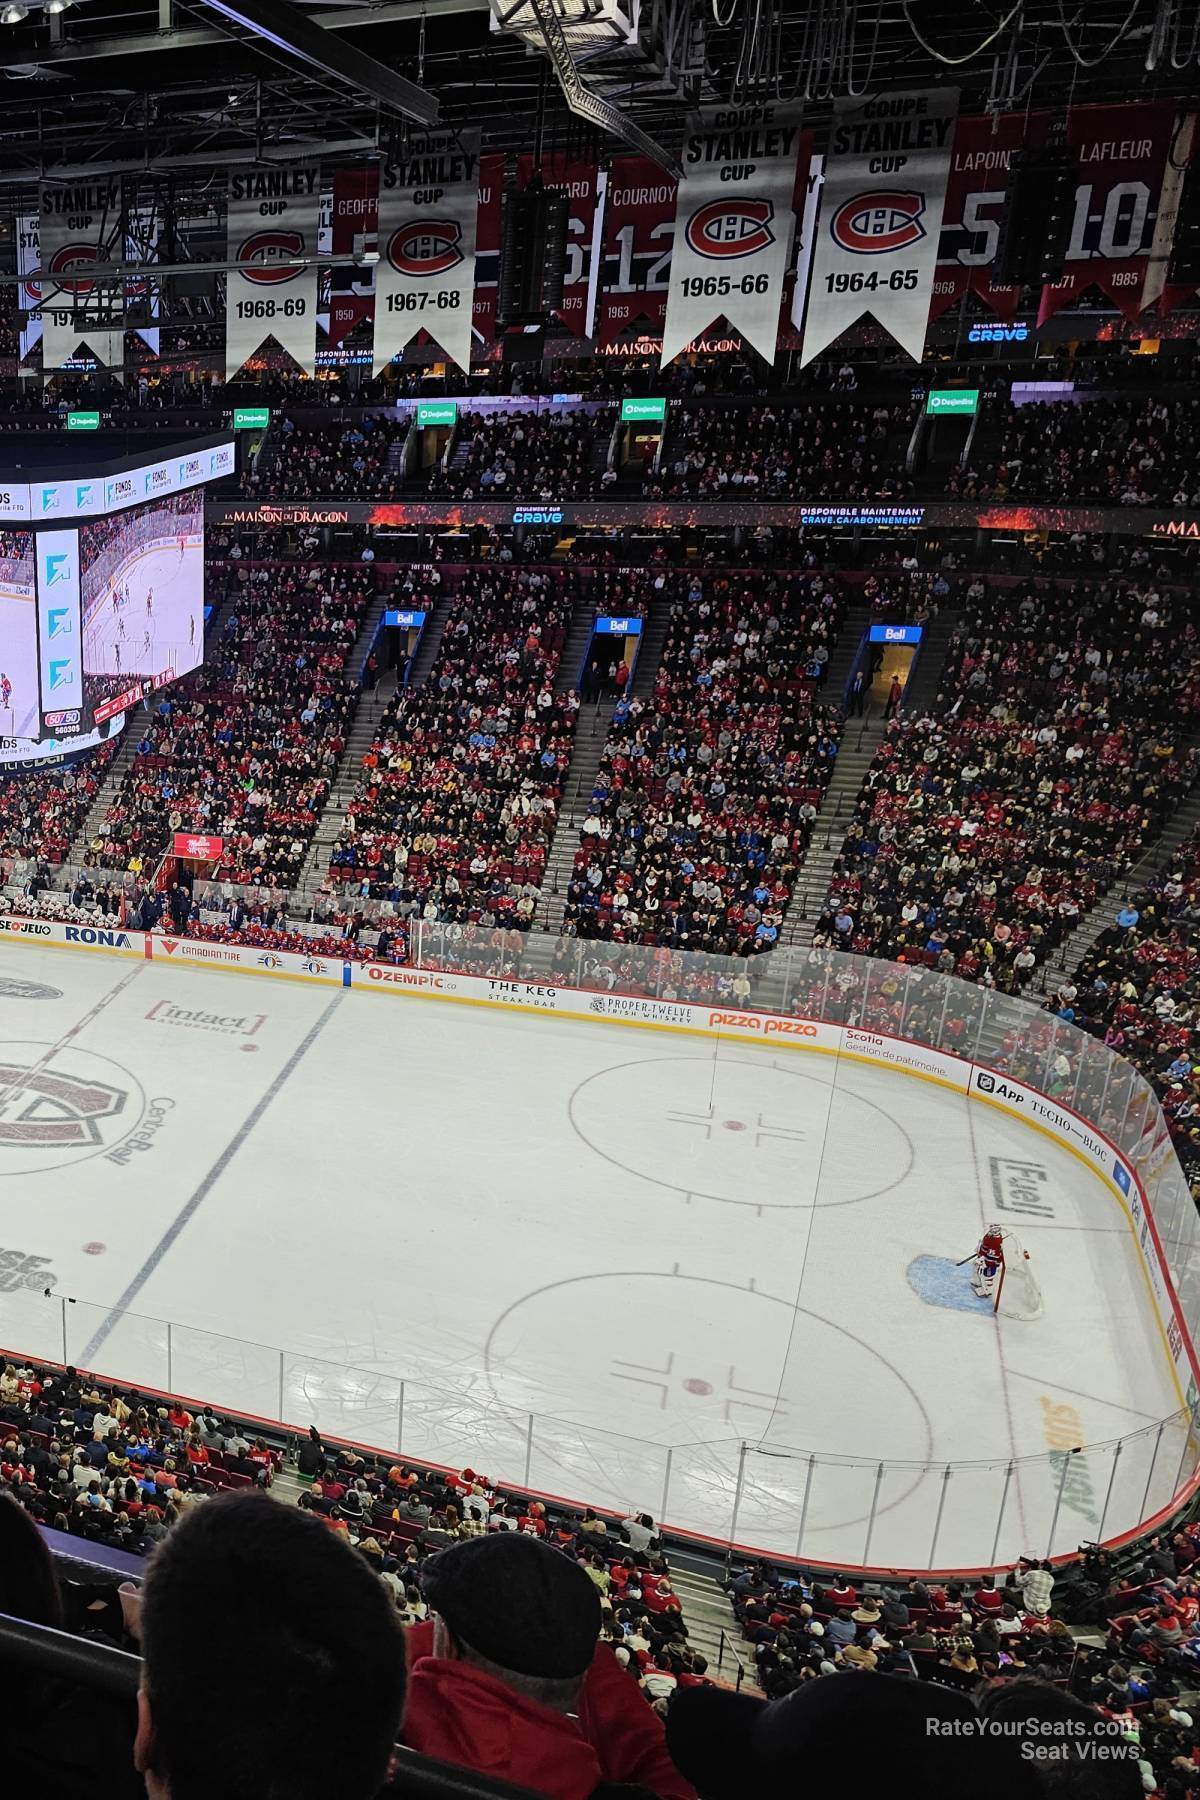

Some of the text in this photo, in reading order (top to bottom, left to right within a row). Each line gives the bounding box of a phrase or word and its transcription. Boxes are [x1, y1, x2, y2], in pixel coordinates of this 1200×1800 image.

[864, 96, 928, 116] COUPE
[715, 108, 775, 129] COUPE
[833, 119, 952, 154] STANLEY
[687, 127, 794, 164] STANLEY
[1080, 140, 1152, 163] LAFLEUR
[383, 154, 476, 187] STANLEY
[720, 165, 756, 181] CUP
[868, 156, 907, 174] CUP
[231, 168, 318, 199] STANLEY
[42, 184, 119, 214] STANLEY
[413, 189, 444, 205] CUP
[259, 201, 288, 217] CUP
[68, 216, 92, 231] CUP
[957, 190, 1006, 267] 5
[1065, 181, 1152, 261] 10
[681, 274, 769, 297] 1965-66
[825, 269, 919, 294] 1964-65
[1110, 272, 1139, 288] 1985
[236, 298, 306, 319] 1968-69
[386, 289, 461, 312] 1967-68
[563, 297, 583, 310] 1975
[335, 308, 355, 321] 1950
[608, 305, 630, 319] 1963
[683, 339, 742, 355] RAGON
[942, 397, 974, 408] Desjardins
[234, 511, 283, 523] MAISON
[293, 511, 349, 523] DRAGON
[801, 507, 926, 517] DISPONIBLE MAINTENANT
[801, 516, 922, 525] CRAVE.CA/ABONNEMENT
[397, 613, 413, 625] Bell
[610, 619, 629, 632] Bell
[886, 628, 906, 641] Bell
[64, 926, 132, 950] RONA
[181, 946, 241, 962] CANADIAN TIRE
[488, 980, 557, 998] THE KEG
[488, 994, 556, 1009] STEAK BAR
[162, 1004, 250, 1030] intact
[643, 1012, 692, 1024] WHISKEY
[708, 1011, 817, 1038] pizza pizza
[845, 1029, 884, 1046] Scotia
[845, 1040, 881, 1058] Gestion
[882, 1048, 894, 1061] de
